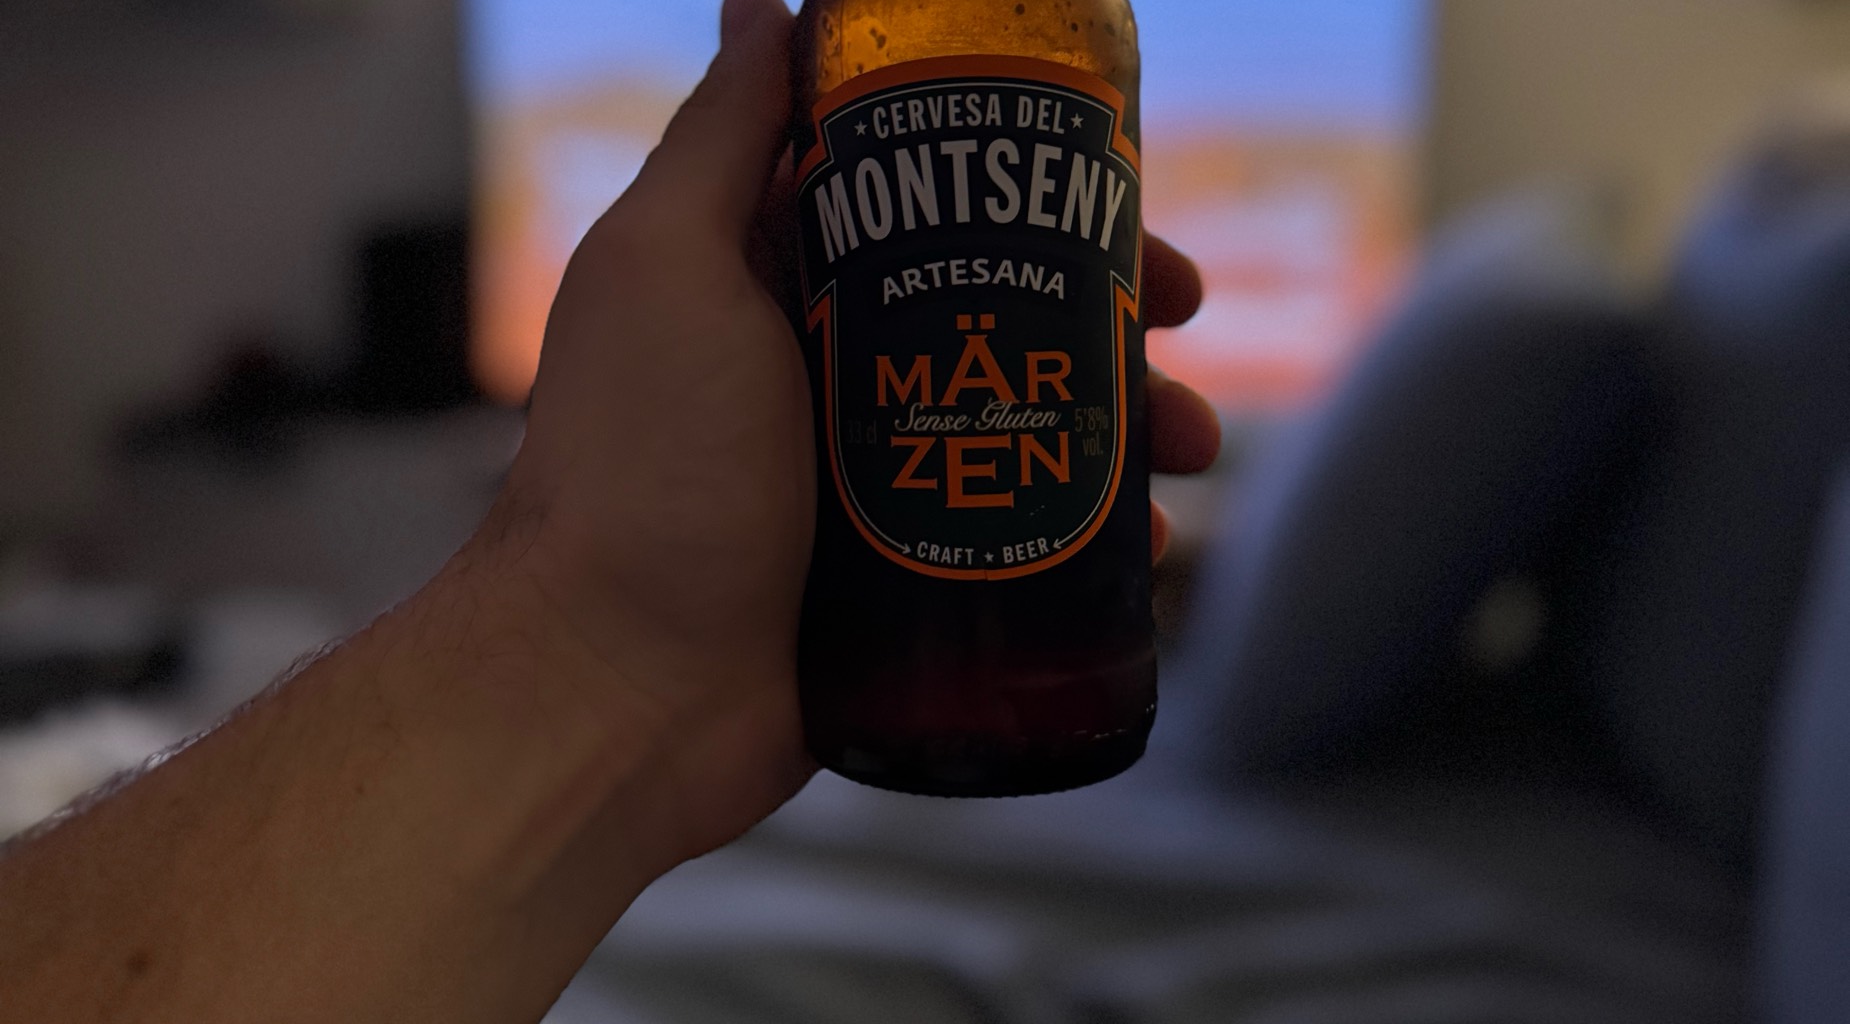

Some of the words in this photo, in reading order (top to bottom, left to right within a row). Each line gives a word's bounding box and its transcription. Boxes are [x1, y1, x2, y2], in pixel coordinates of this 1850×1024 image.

[872, 93, 1002, 140] CERVESA
[1016, 95, 1065, 135] DEL
[814, 137, 1127, 264] MONTSENY
[882, 257, 1065, 306] ARTESANA
[874, 313, 1075, 407] MÄR
[894, 402, 972, 432] Sense
[974, 396, 1062, 431] Gluten
[890, 431, 1071, 509] ZEN
[916, 540, 974, 565] CRAFT
[1002, 537, 1050, 564] BEER
